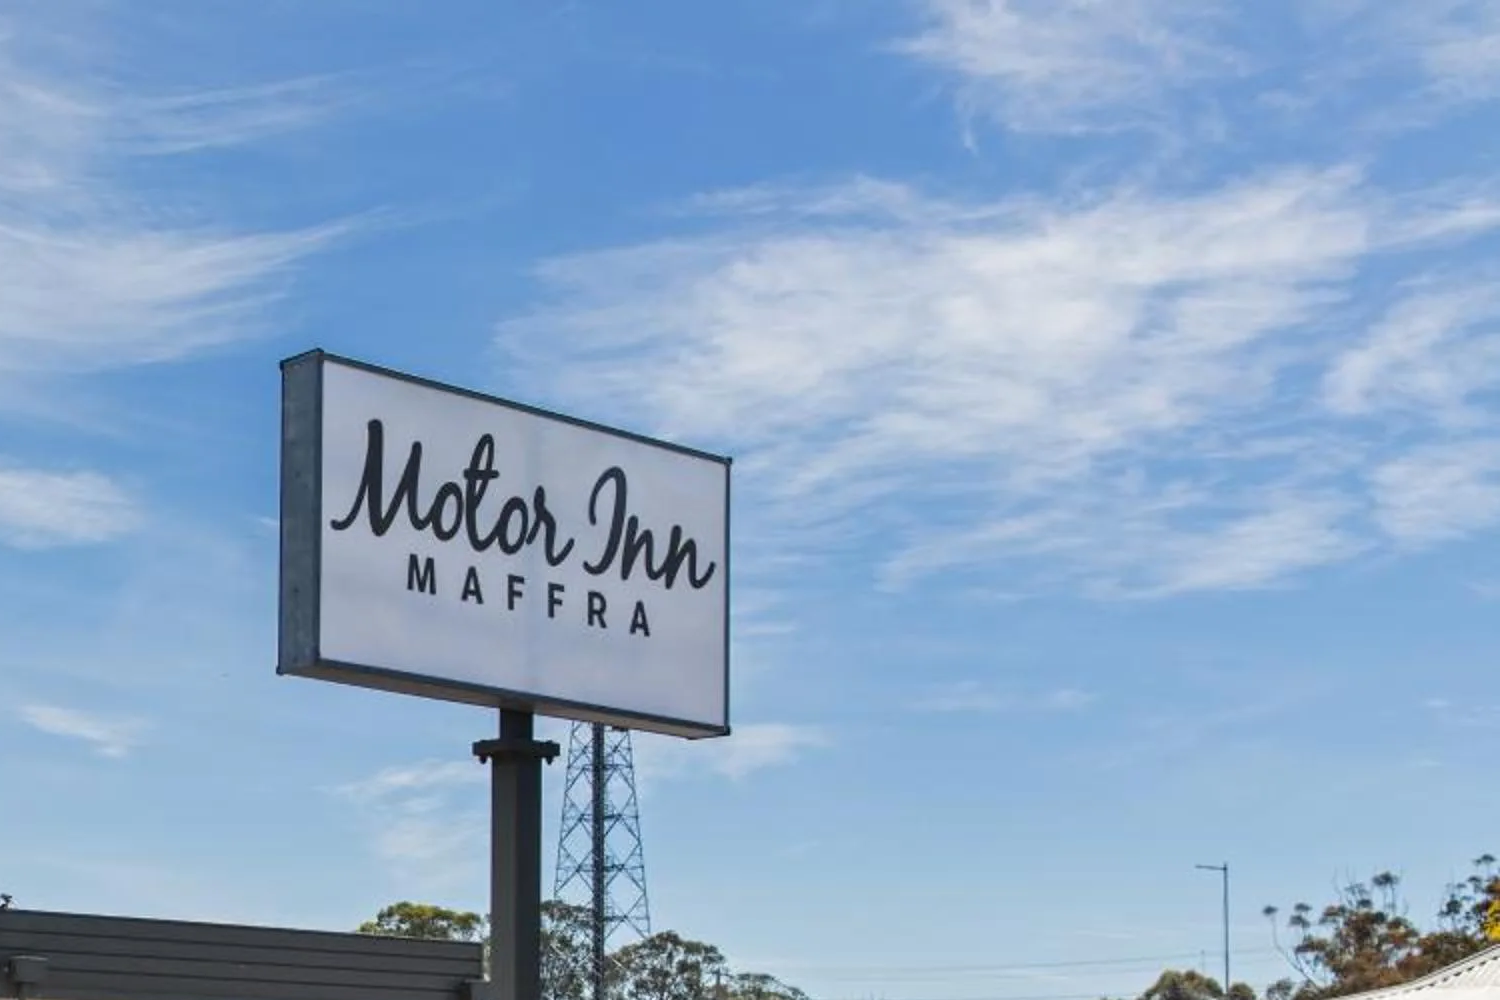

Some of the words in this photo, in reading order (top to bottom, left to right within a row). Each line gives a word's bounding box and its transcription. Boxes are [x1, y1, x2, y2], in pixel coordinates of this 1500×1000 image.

[330, 418, 575, 567] Motor
[583, 465, 717, 590] Inn
[406, 553, 651, 637] MAFFRA
